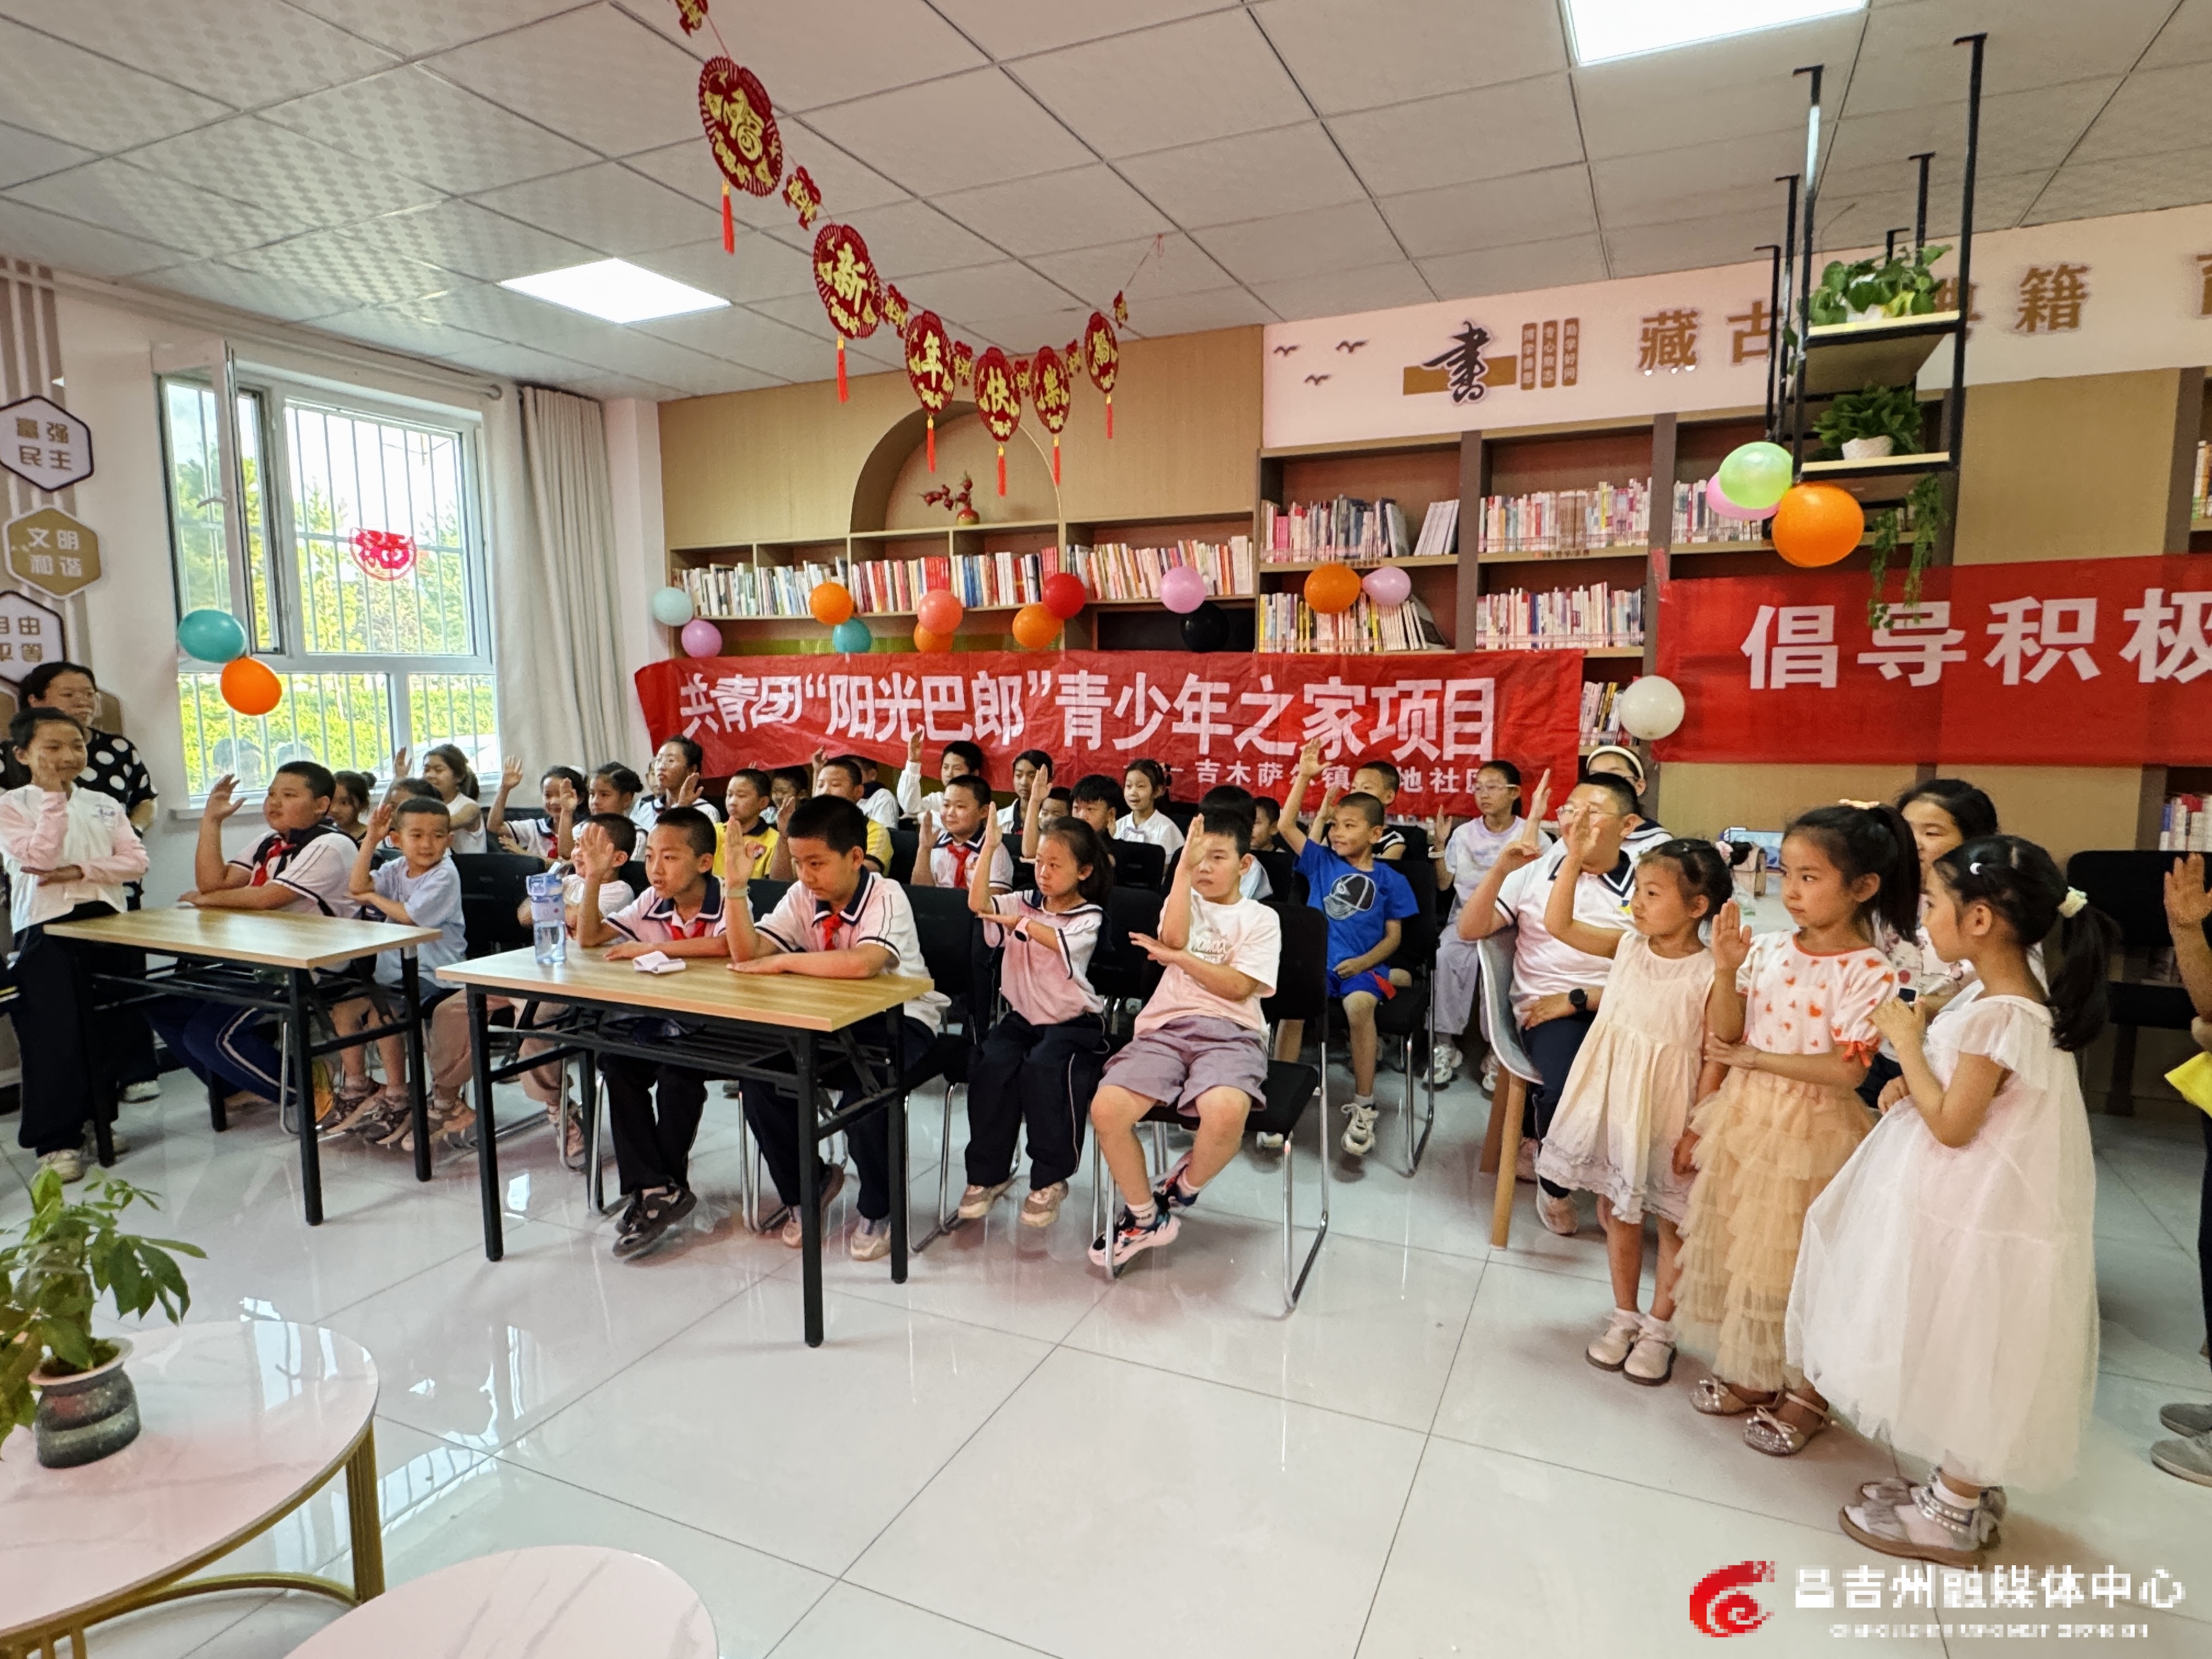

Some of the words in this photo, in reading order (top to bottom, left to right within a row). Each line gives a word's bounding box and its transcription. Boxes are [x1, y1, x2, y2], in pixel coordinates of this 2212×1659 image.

[920, 329, 944, 388] 年
[988, 365, 1011, 414] 快
[19, 444, 73, 471] 民主
[27, 528, 80, 551] 文明
[1741, 587, 2212, 690] 倡导积极
